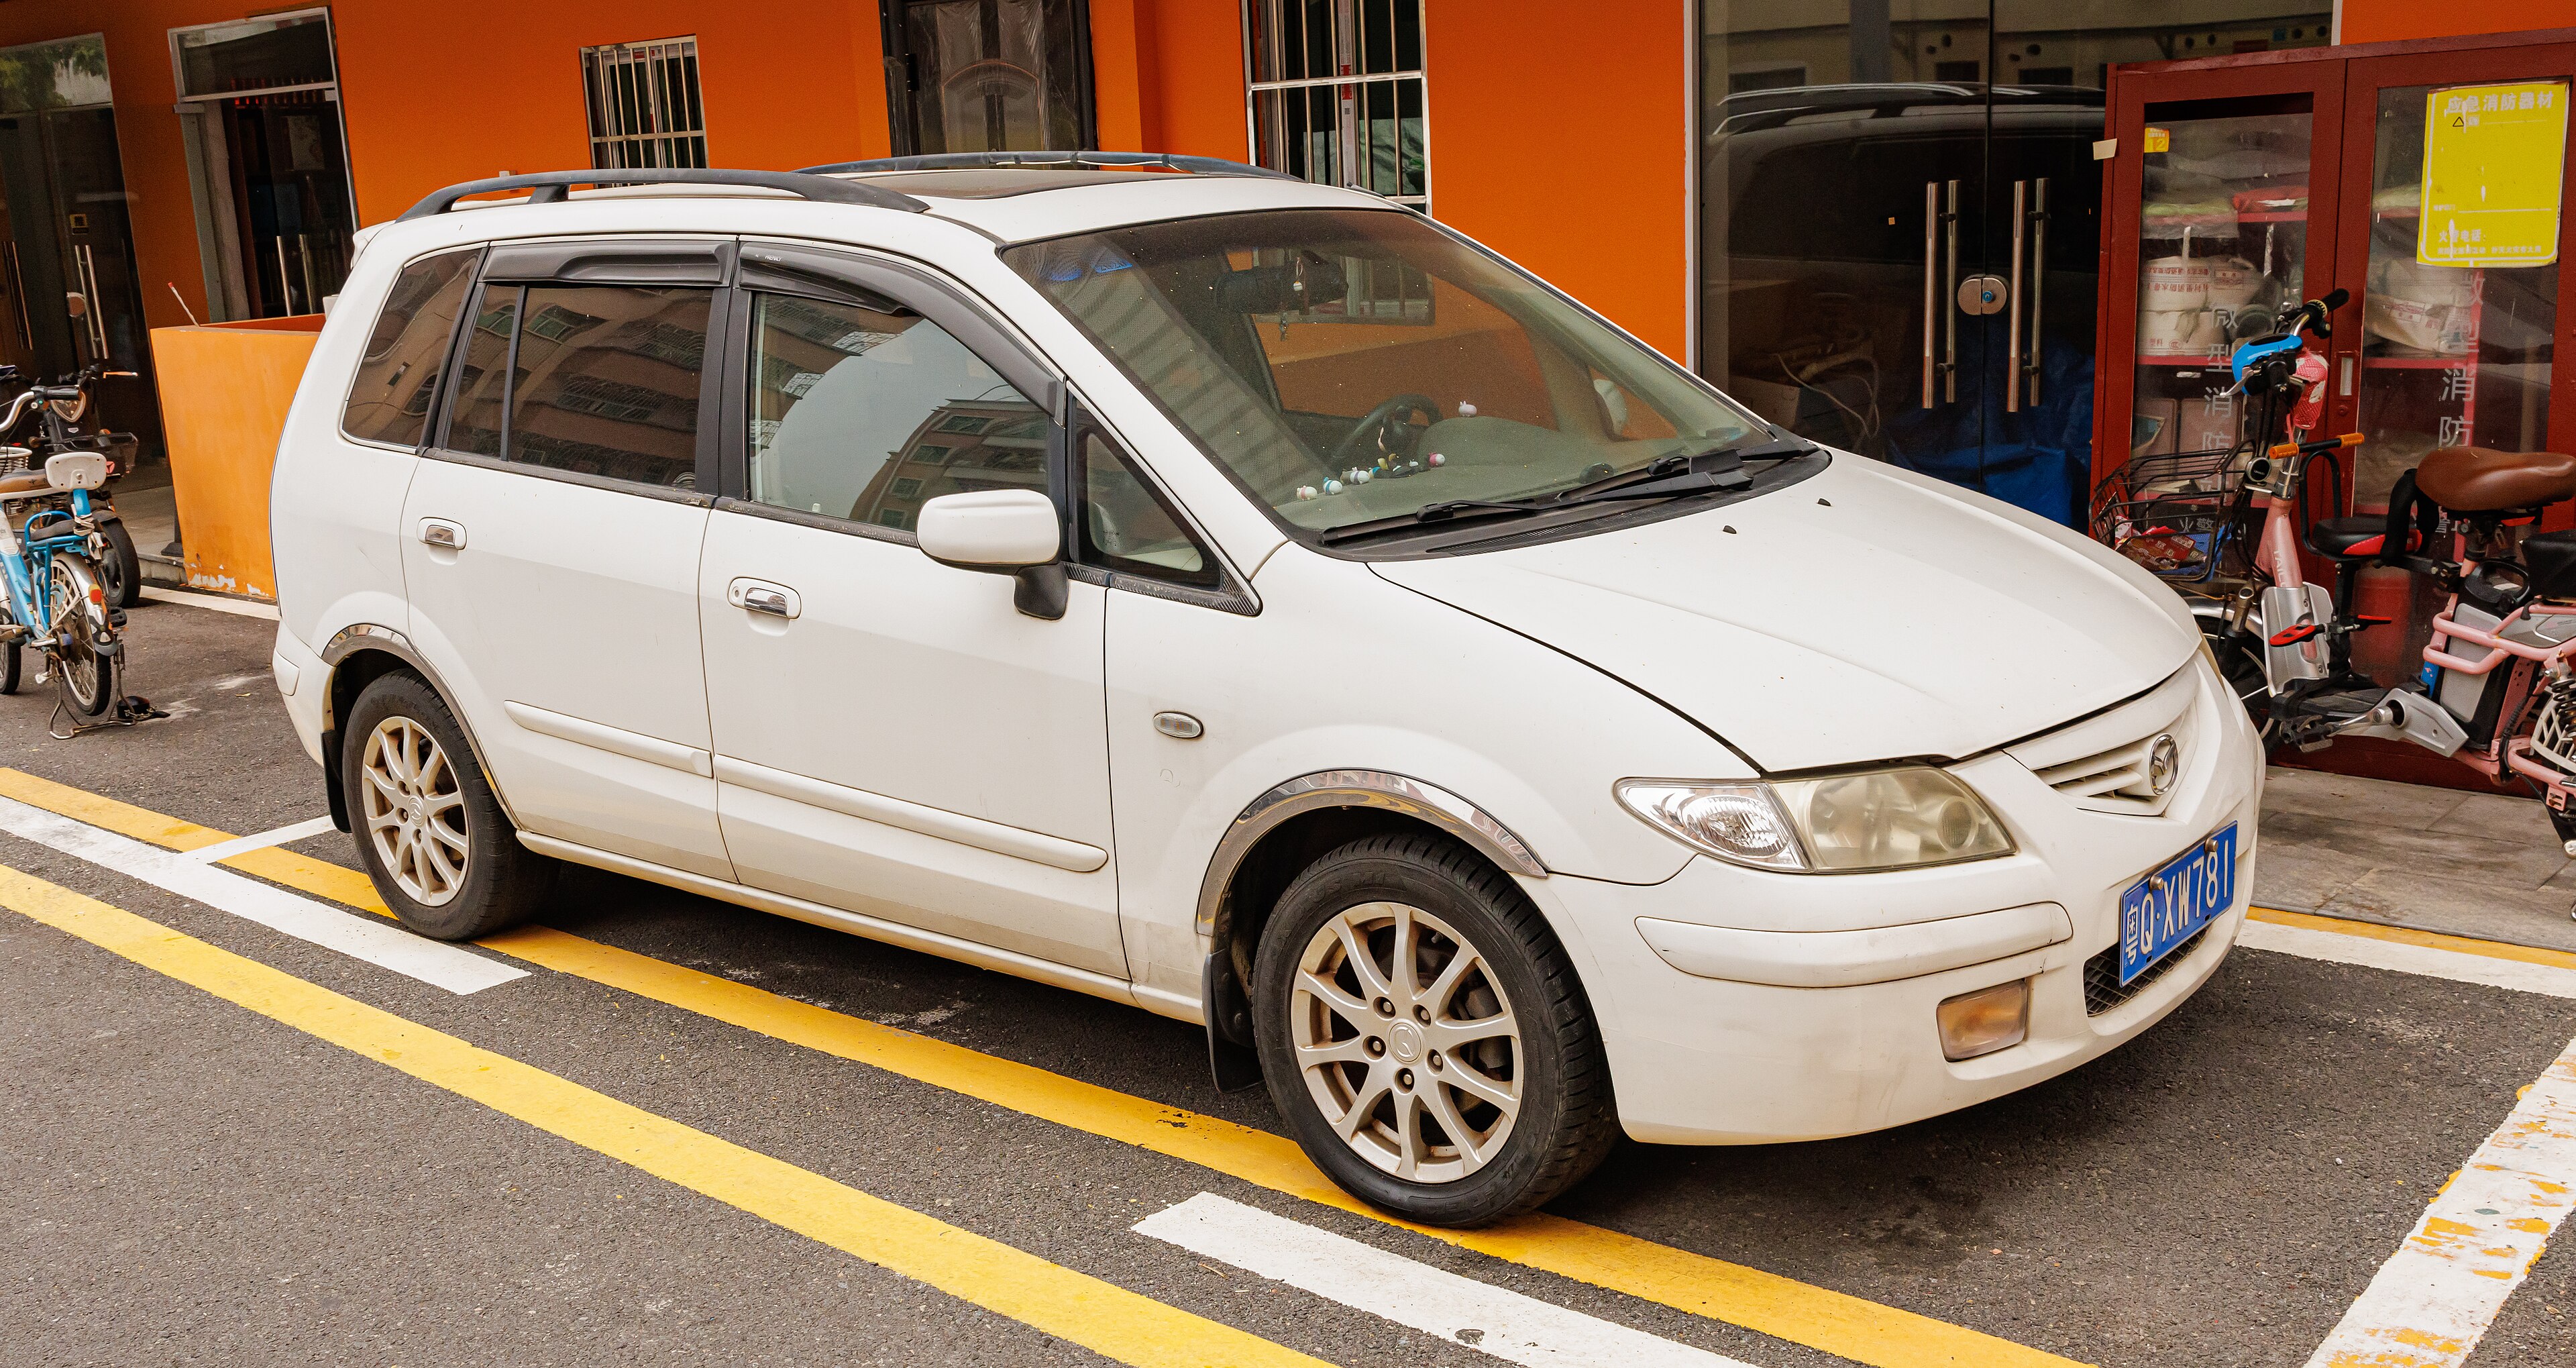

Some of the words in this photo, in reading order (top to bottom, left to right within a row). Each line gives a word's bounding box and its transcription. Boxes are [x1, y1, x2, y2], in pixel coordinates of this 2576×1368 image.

[2447, 91, 2554, 114] 应急消防器材
